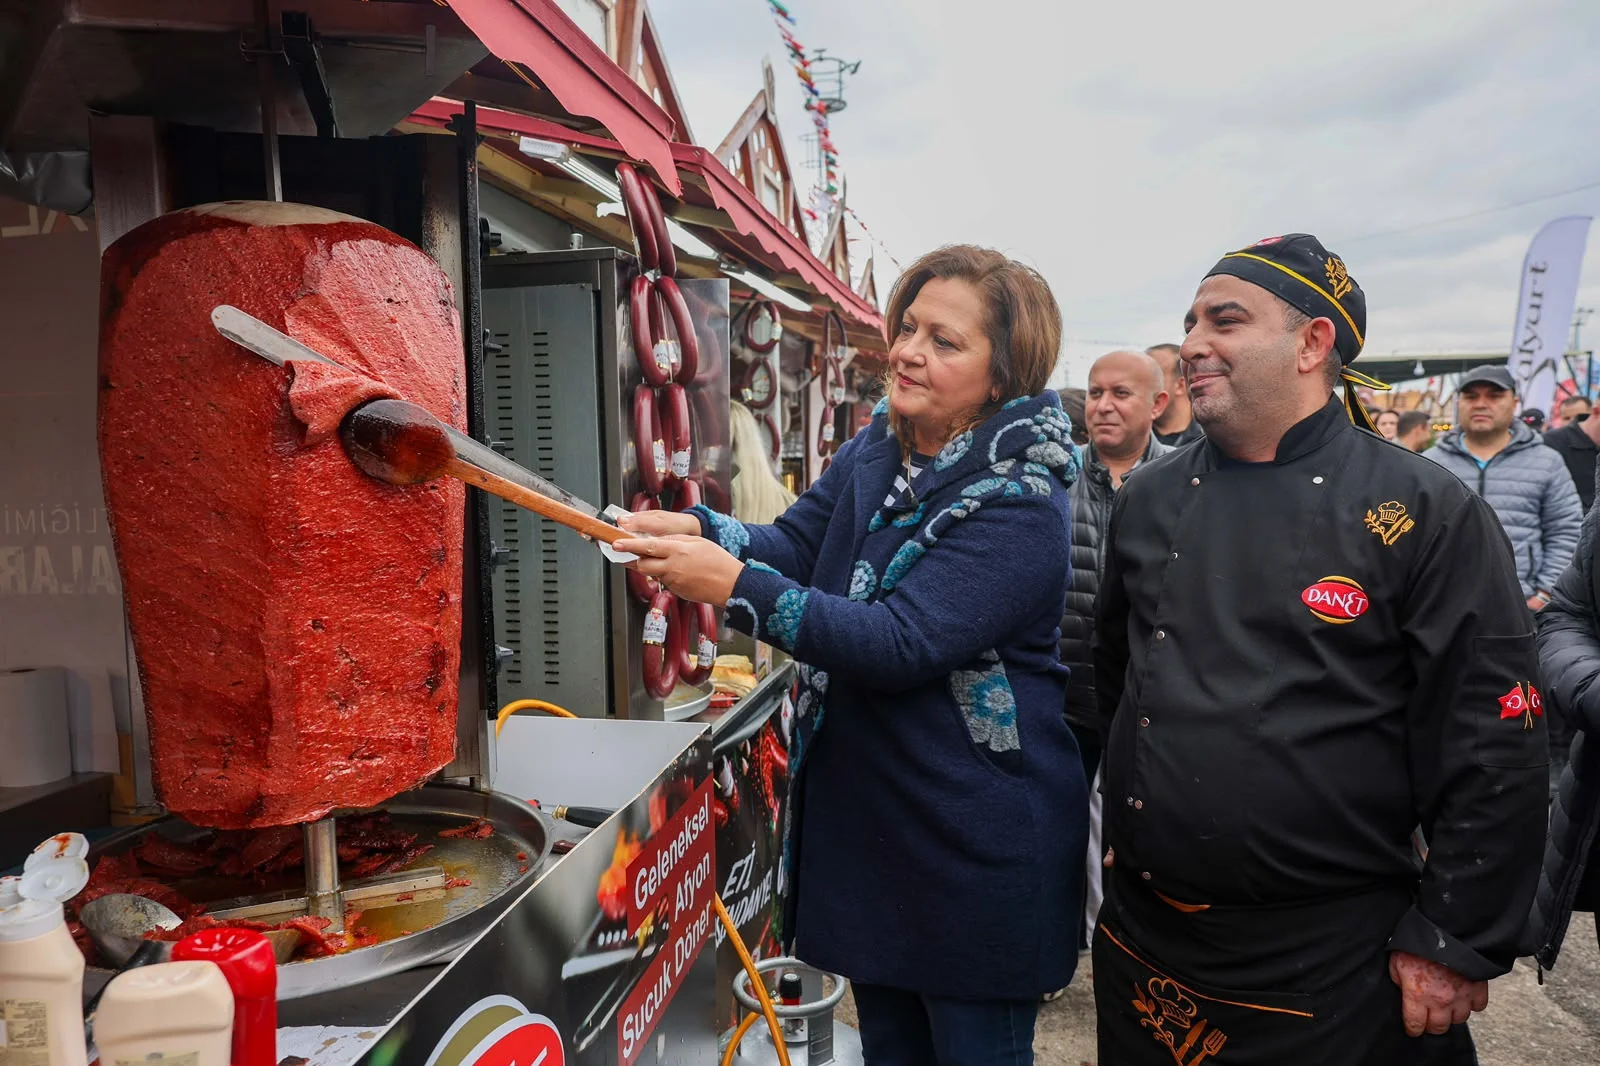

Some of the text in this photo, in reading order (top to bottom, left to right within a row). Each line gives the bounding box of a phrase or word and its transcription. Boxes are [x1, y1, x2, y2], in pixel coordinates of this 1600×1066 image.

[1307, 588, 1366, 617] DANET
[634, 793, 709, 910] Geleneksel
[722, 840, 755, 901] ETİ
[674, 852, 710, 922] Afyon
[622, 900, 711, 1059] Sucuk Döner
